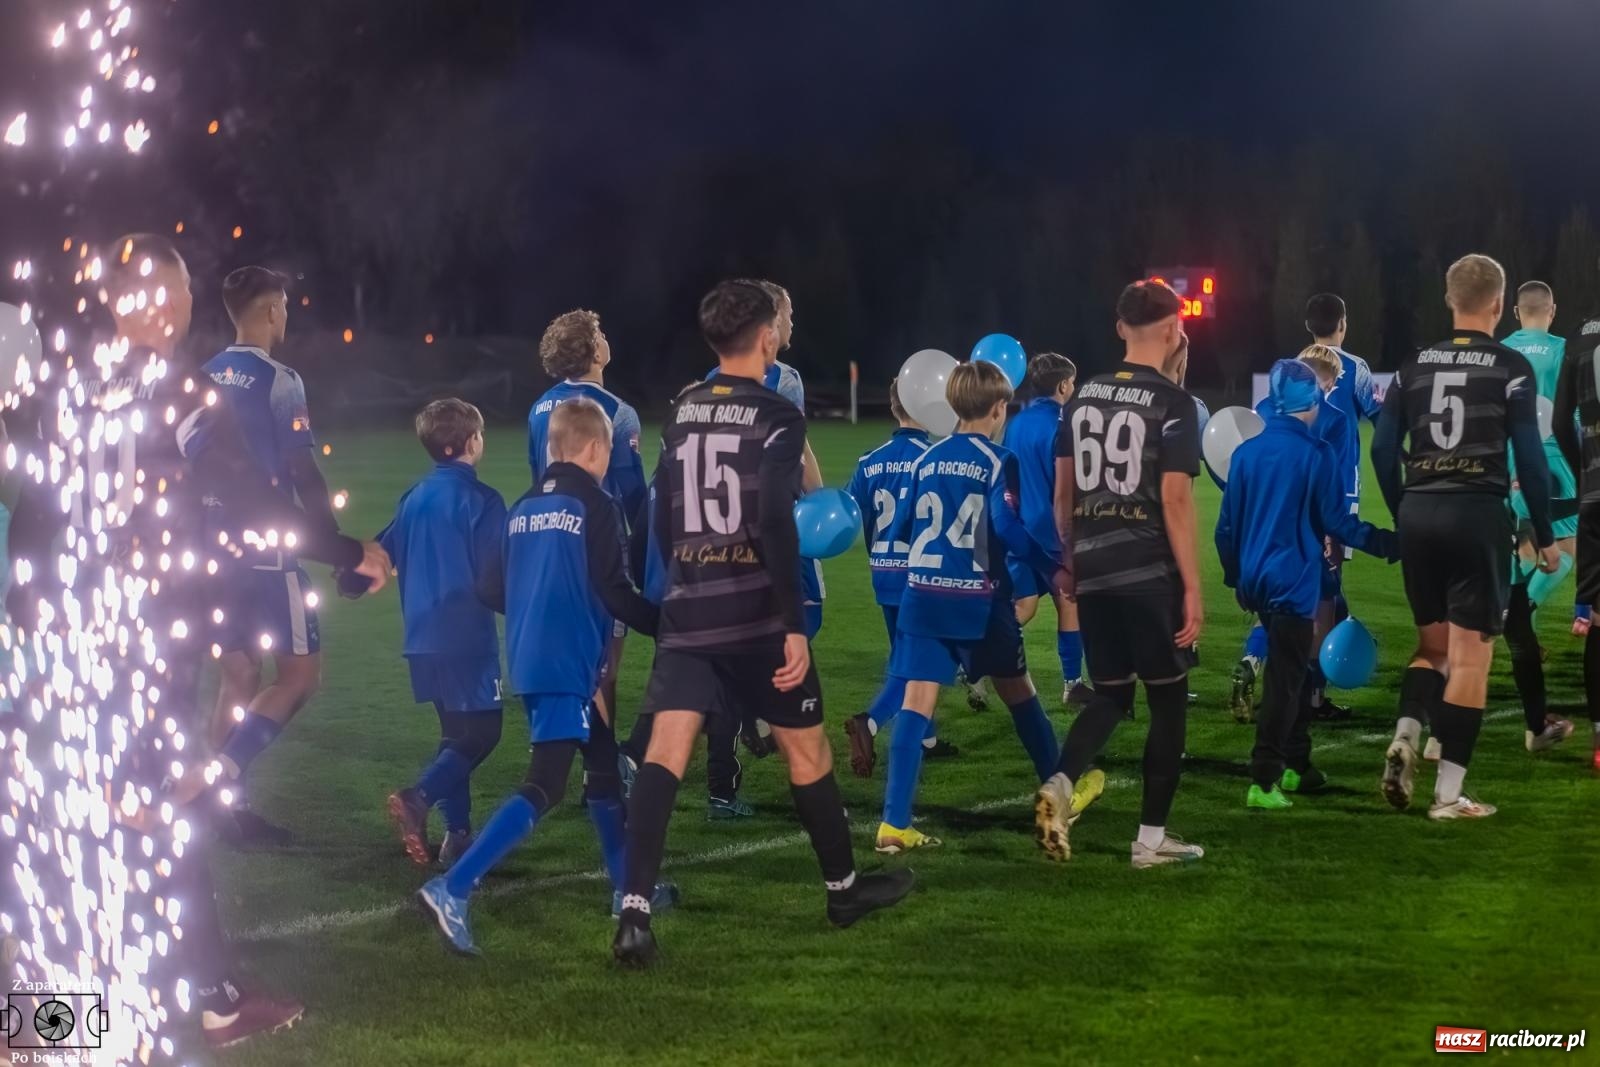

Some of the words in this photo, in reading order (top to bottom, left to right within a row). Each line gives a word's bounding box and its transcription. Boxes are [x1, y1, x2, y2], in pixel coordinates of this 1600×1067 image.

[1429, 371, 1468, 450] 5
[676, 432, 742, 535] 15
[864, 462, 884, 479] UNIA
[937, 460, 989, 483] RACIBÓRZ
[1071, 405, 1147, 496] 69
[529, 509, 583, 535] RACIBÓRZ
[907, 491, 986, 572] 24
